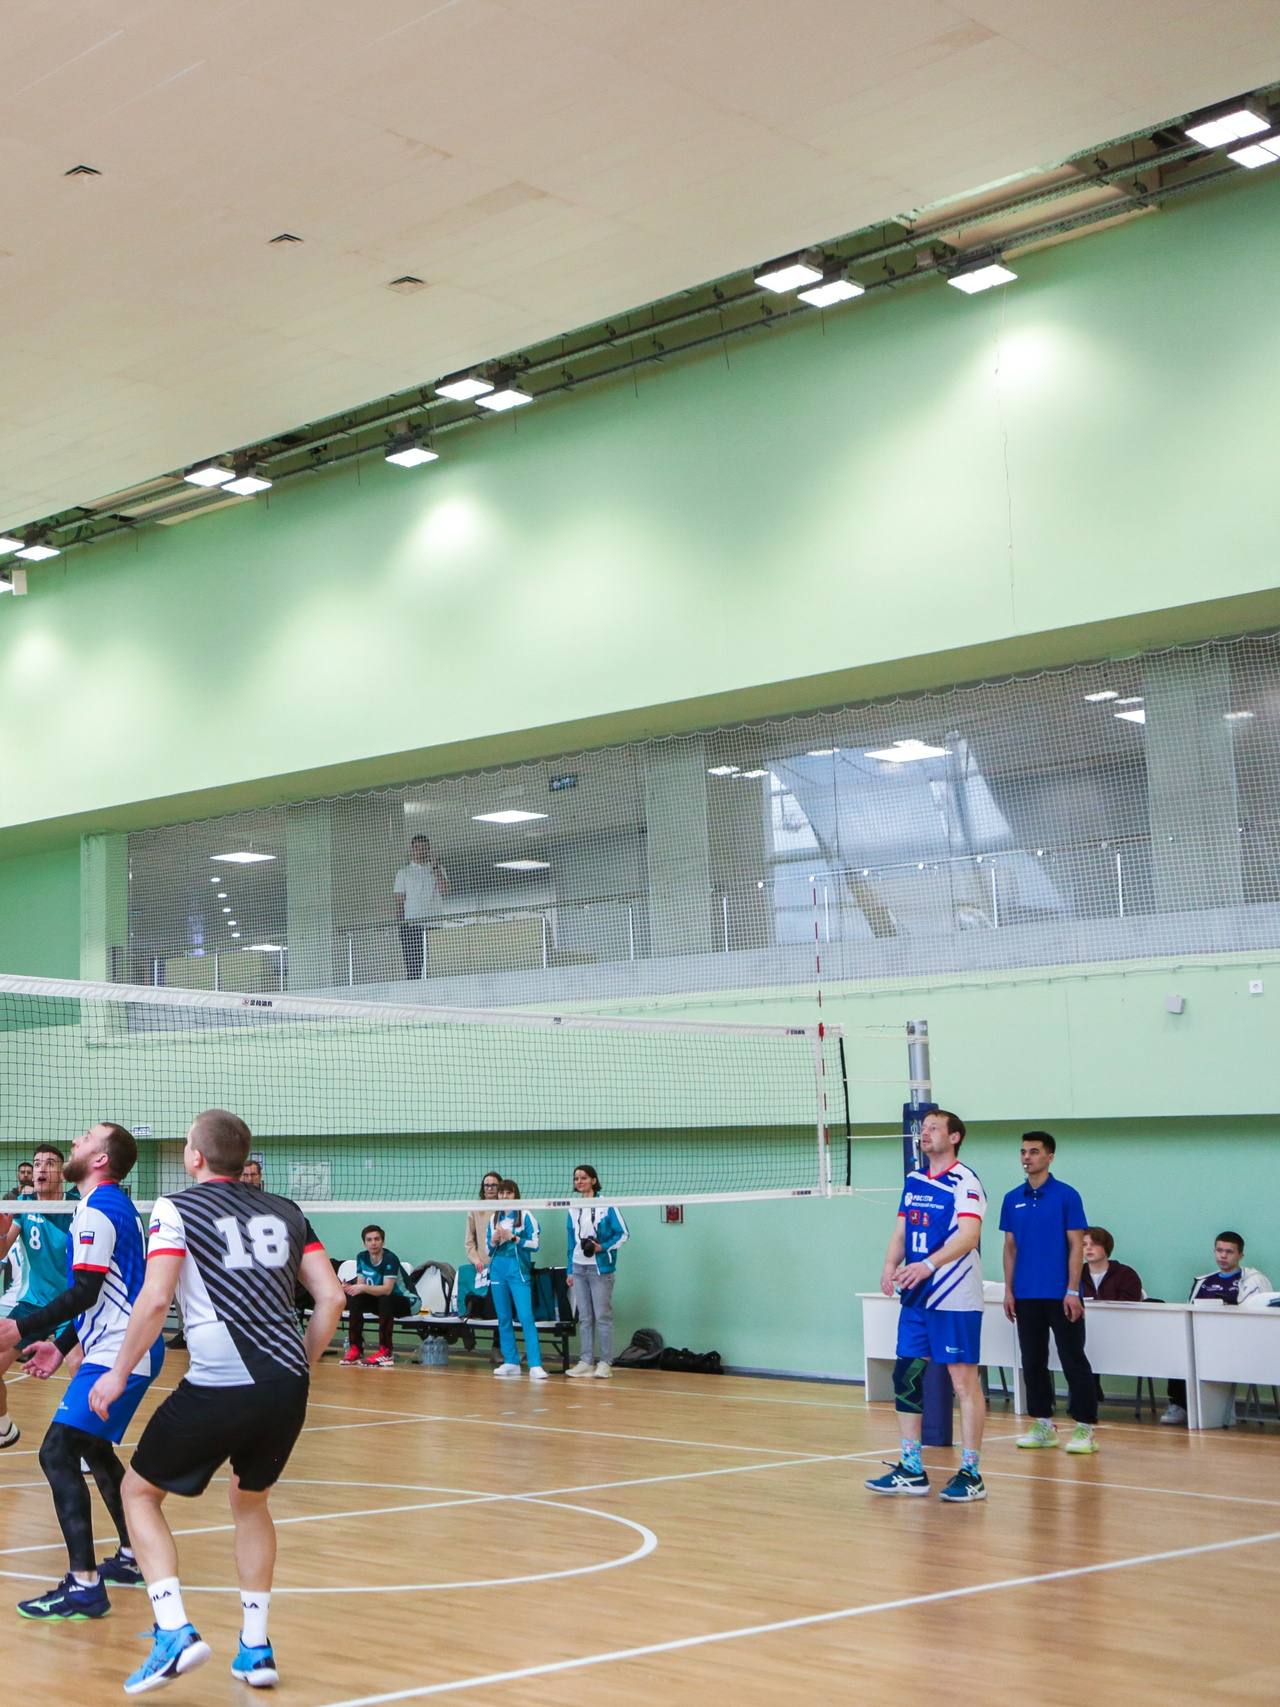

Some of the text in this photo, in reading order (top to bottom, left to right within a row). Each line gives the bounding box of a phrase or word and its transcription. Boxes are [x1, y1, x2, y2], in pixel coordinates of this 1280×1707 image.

[29, 1226, 41, 1250] 8
[213, 1214, 290, 1269] 18
[912, 1231, 928, 1253] 11
